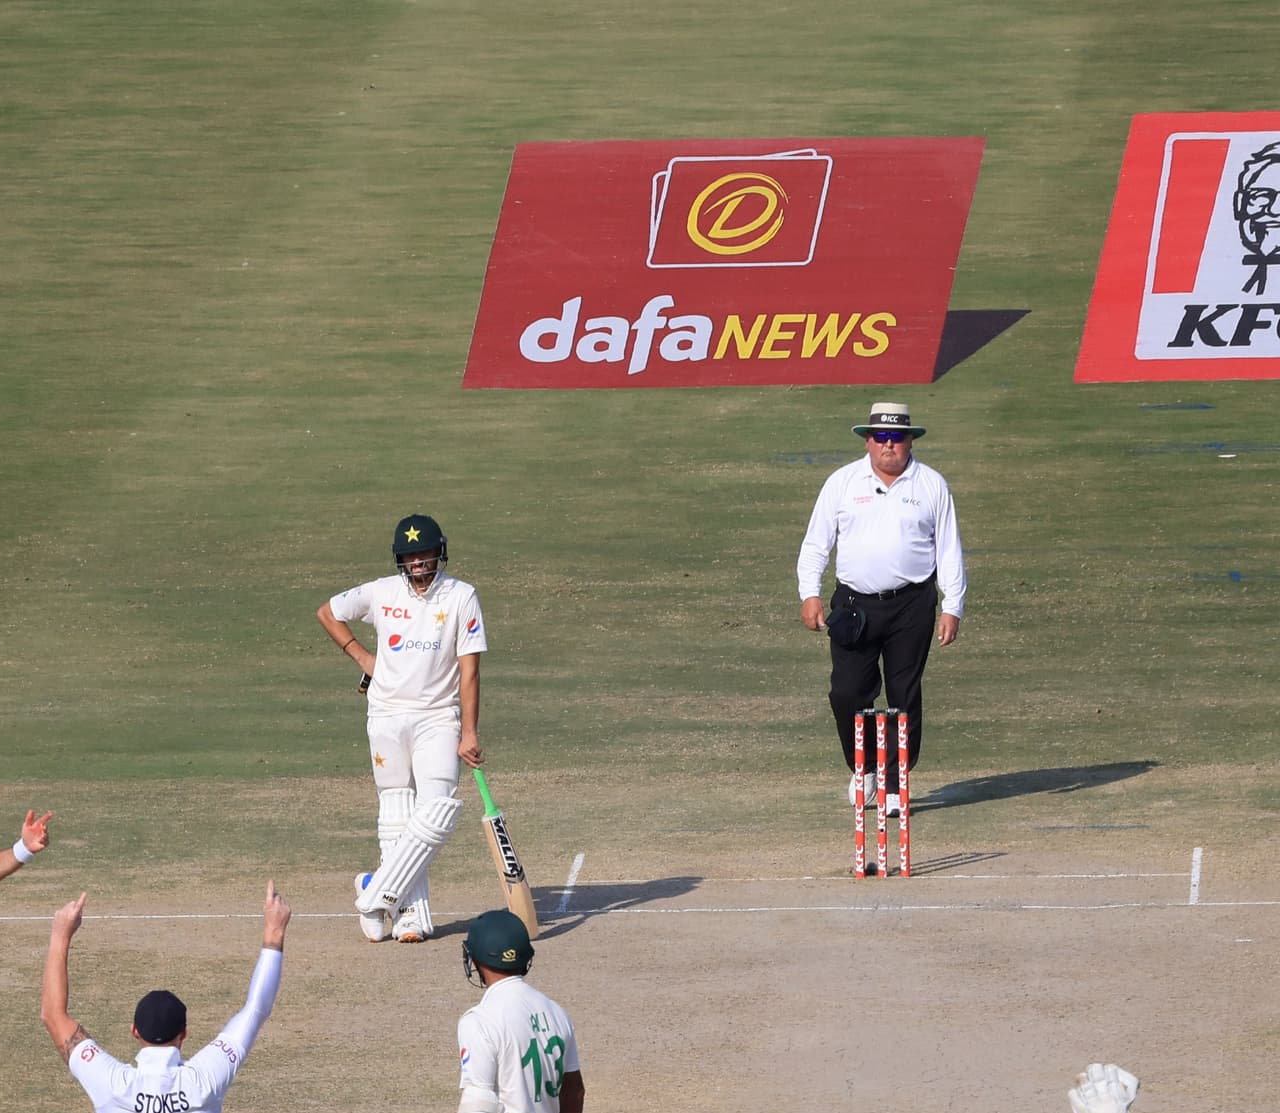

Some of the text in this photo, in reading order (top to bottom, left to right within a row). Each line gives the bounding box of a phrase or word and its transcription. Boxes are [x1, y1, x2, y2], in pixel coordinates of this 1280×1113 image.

[887, 415, 899, 423] ICC
[382, 605, 412, 619] TCL
[405, 639, 441, 653] pepsi
[855, 722, 864, 750] KFC
[876, 721, 886, 749] KFC
[898, 721, 907, 749] KFC
[856, 763, 864, 791] KFC
[877, 762, 886, 790] KFC
[899, 762, 908, 790] KFC
[856, 804, 864, 832] KFC
[877, 803, 886, 831] KFC
[899, 803, 908, 831] KFC
[493, 817, 521, 875] MALIK
[856, 845, 864, 873] KFC
[877, 844, 886, 872] KFC
[899, 844, 908, 872] KFC
[531, 1011, 549, 1033] ALI
[520, 1035, 565, 1103] 13
